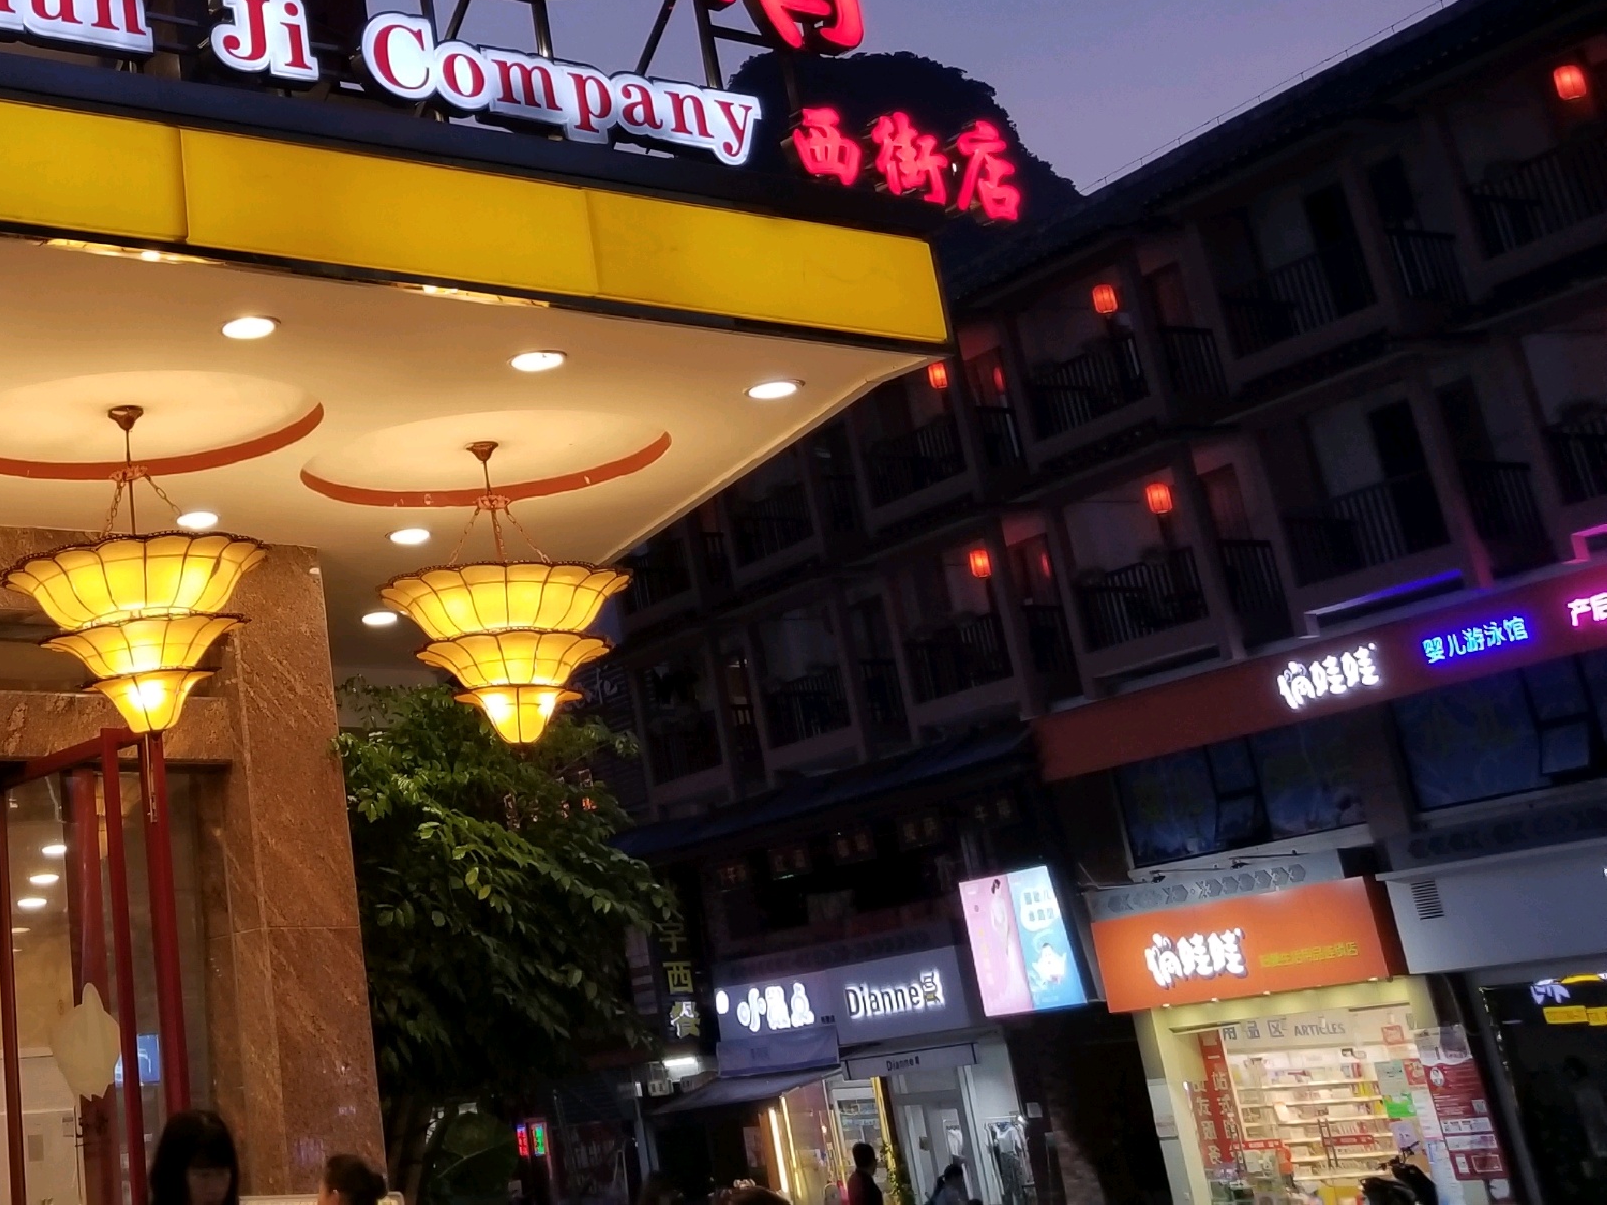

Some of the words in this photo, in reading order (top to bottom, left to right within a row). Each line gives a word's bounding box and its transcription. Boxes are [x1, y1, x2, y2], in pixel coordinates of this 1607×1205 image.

[373, 24, 755, 154] Company
[794, 107, 1022, 221] 西街店
[1422, 616, 1528, 664] 婴儿游泳馆
[844, 981, 921, 1019] Dianne
